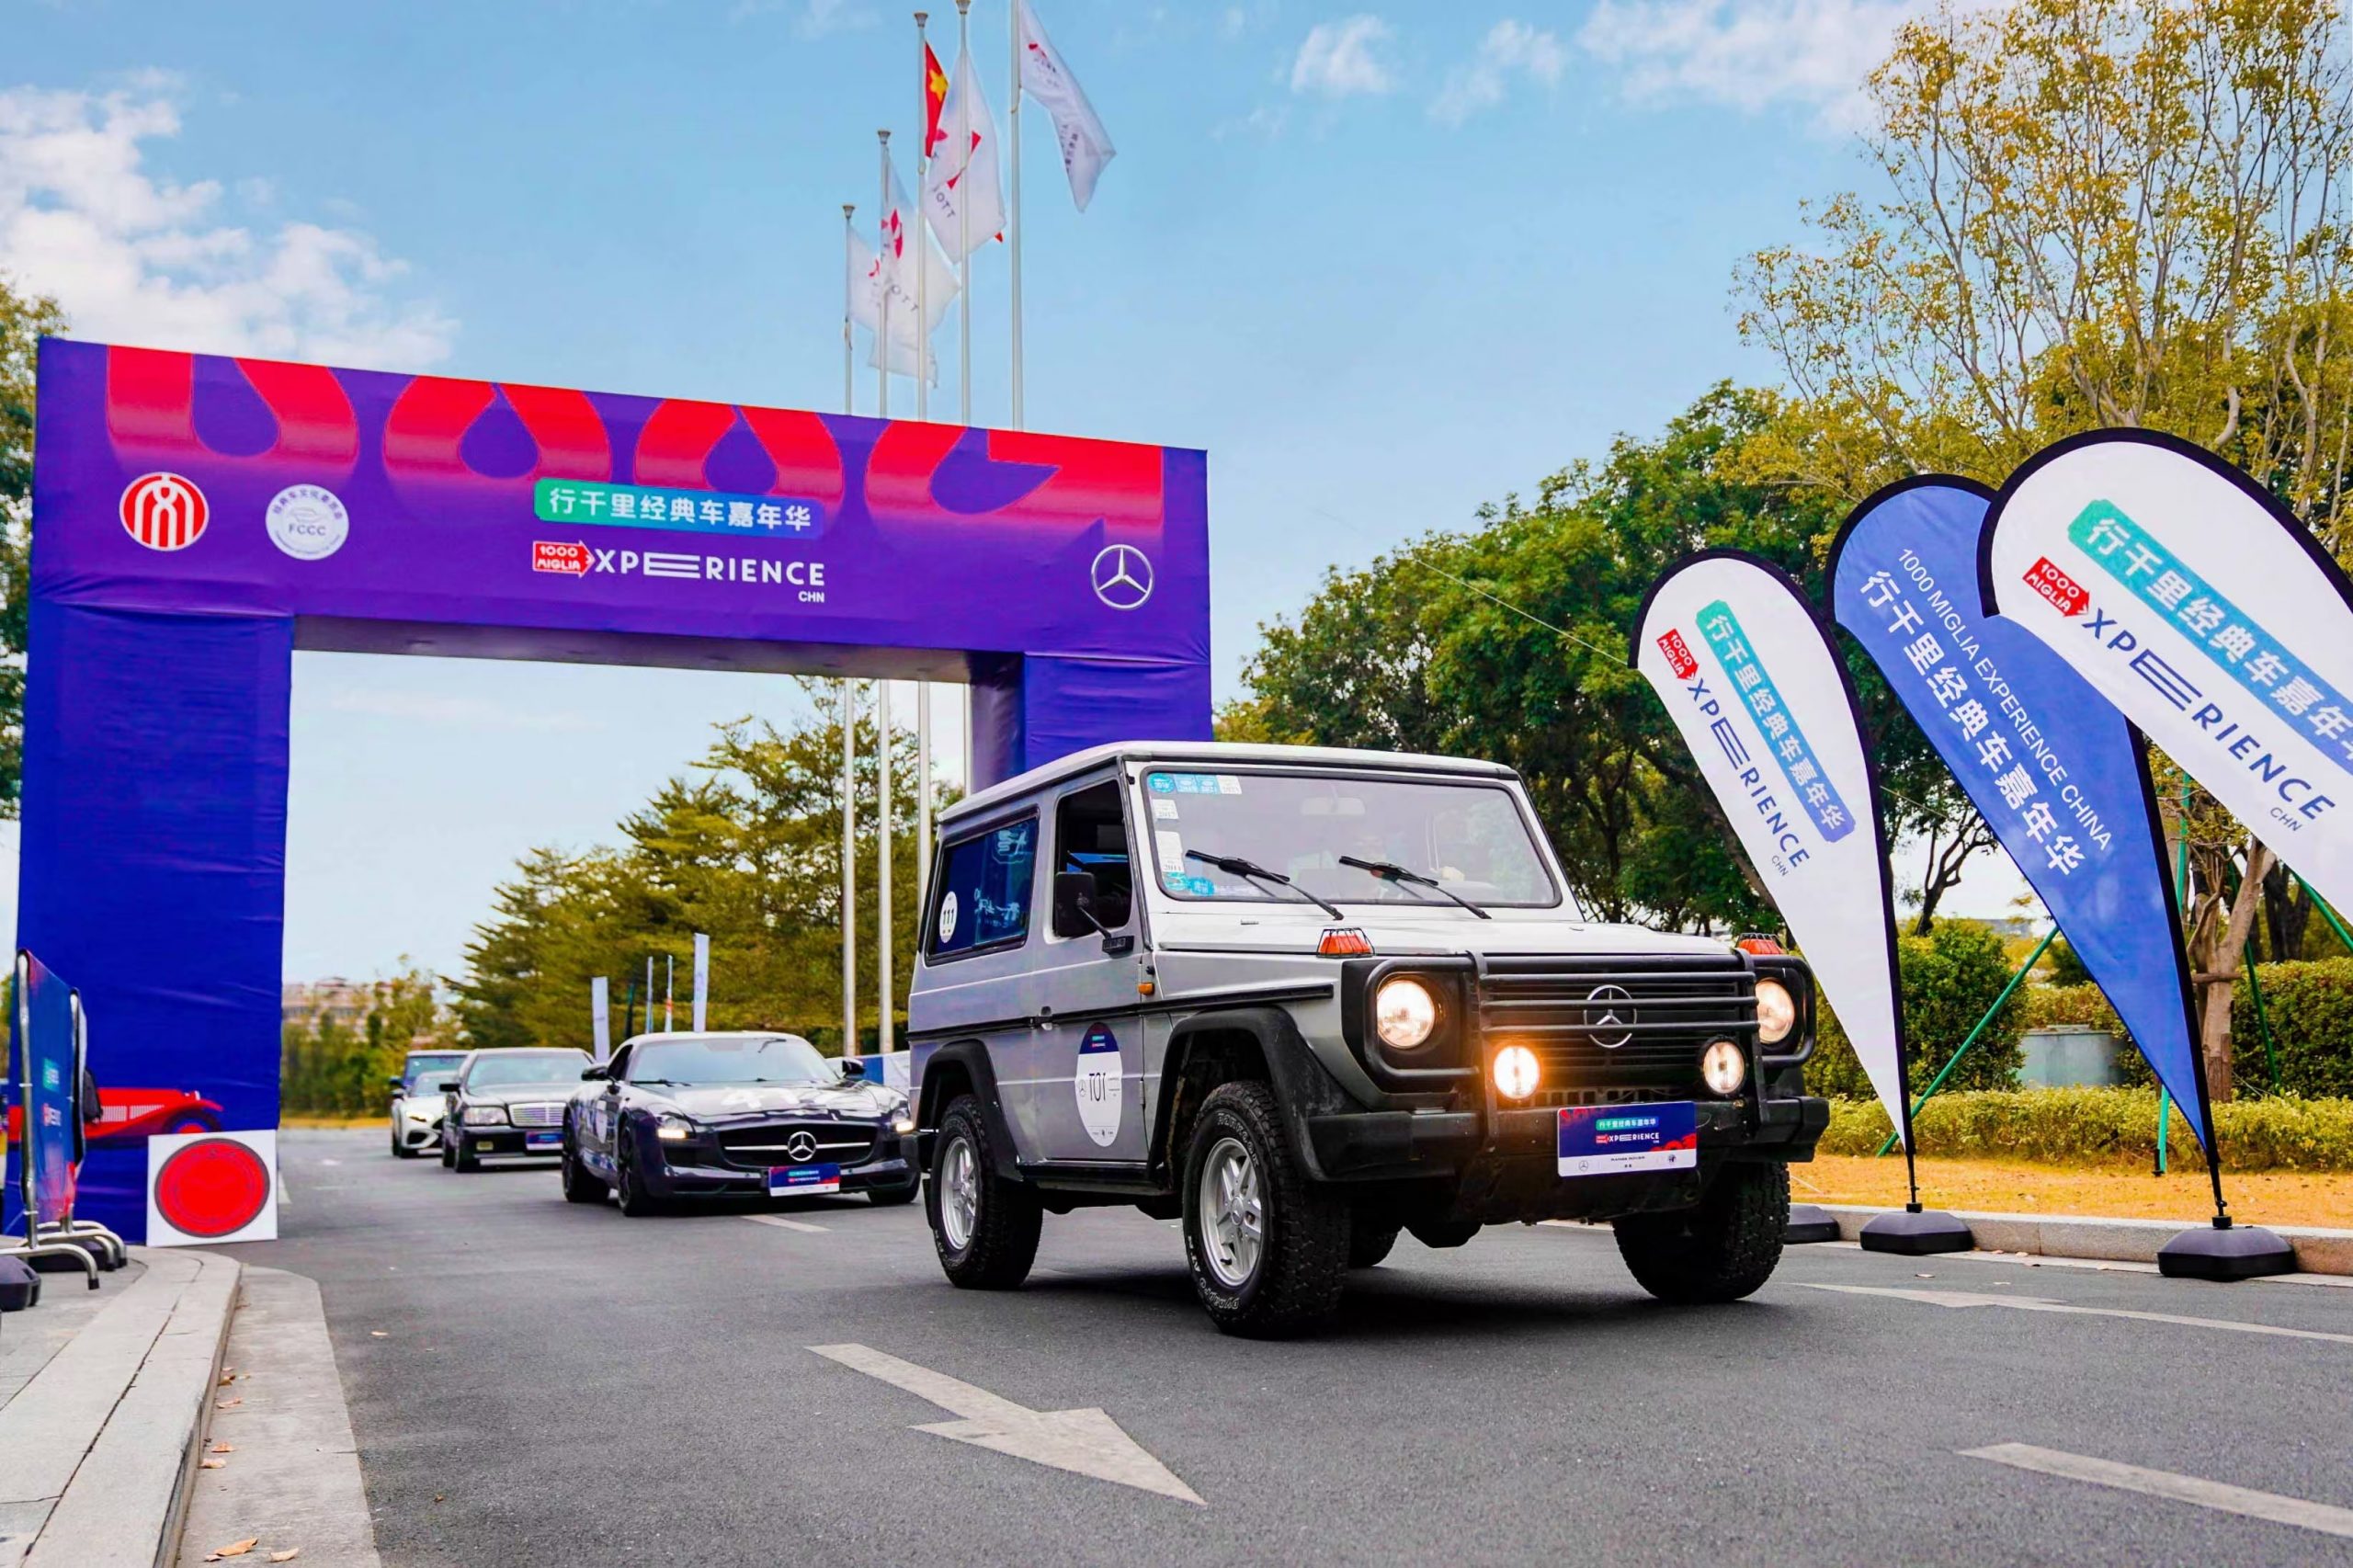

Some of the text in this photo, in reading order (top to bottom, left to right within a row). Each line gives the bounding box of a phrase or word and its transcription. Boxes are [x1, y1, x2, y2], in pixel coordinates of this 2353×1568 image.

[549, 487, 811, 531] 行千里经典车嘉年华
[289, 523, 325, 536] FCCC
[537, 558, 581, 570] MIGLIA
[539, 545, 578, 557] 1000
[798, 590, 824, 603] CHN
[2026, 572, 2071, 614] MIGLIA
[2040, 561, 2080, 599] 1000
[1659, 639, 1685, 676] MIGLIA
[1670, 634, 1692, 666] 1000
[1899, 548, 2111, 852] 1000 MIGLIA EXPERIENCE CHINA
[1705, 614, 1846, 831] 行千里经典车嘉年华
[1859, 570, 2087, 876] 行千里经典车嘉年华
[2270, 807, 2303, 832] CHN
[1770, 854, 1789, 877] CHN
